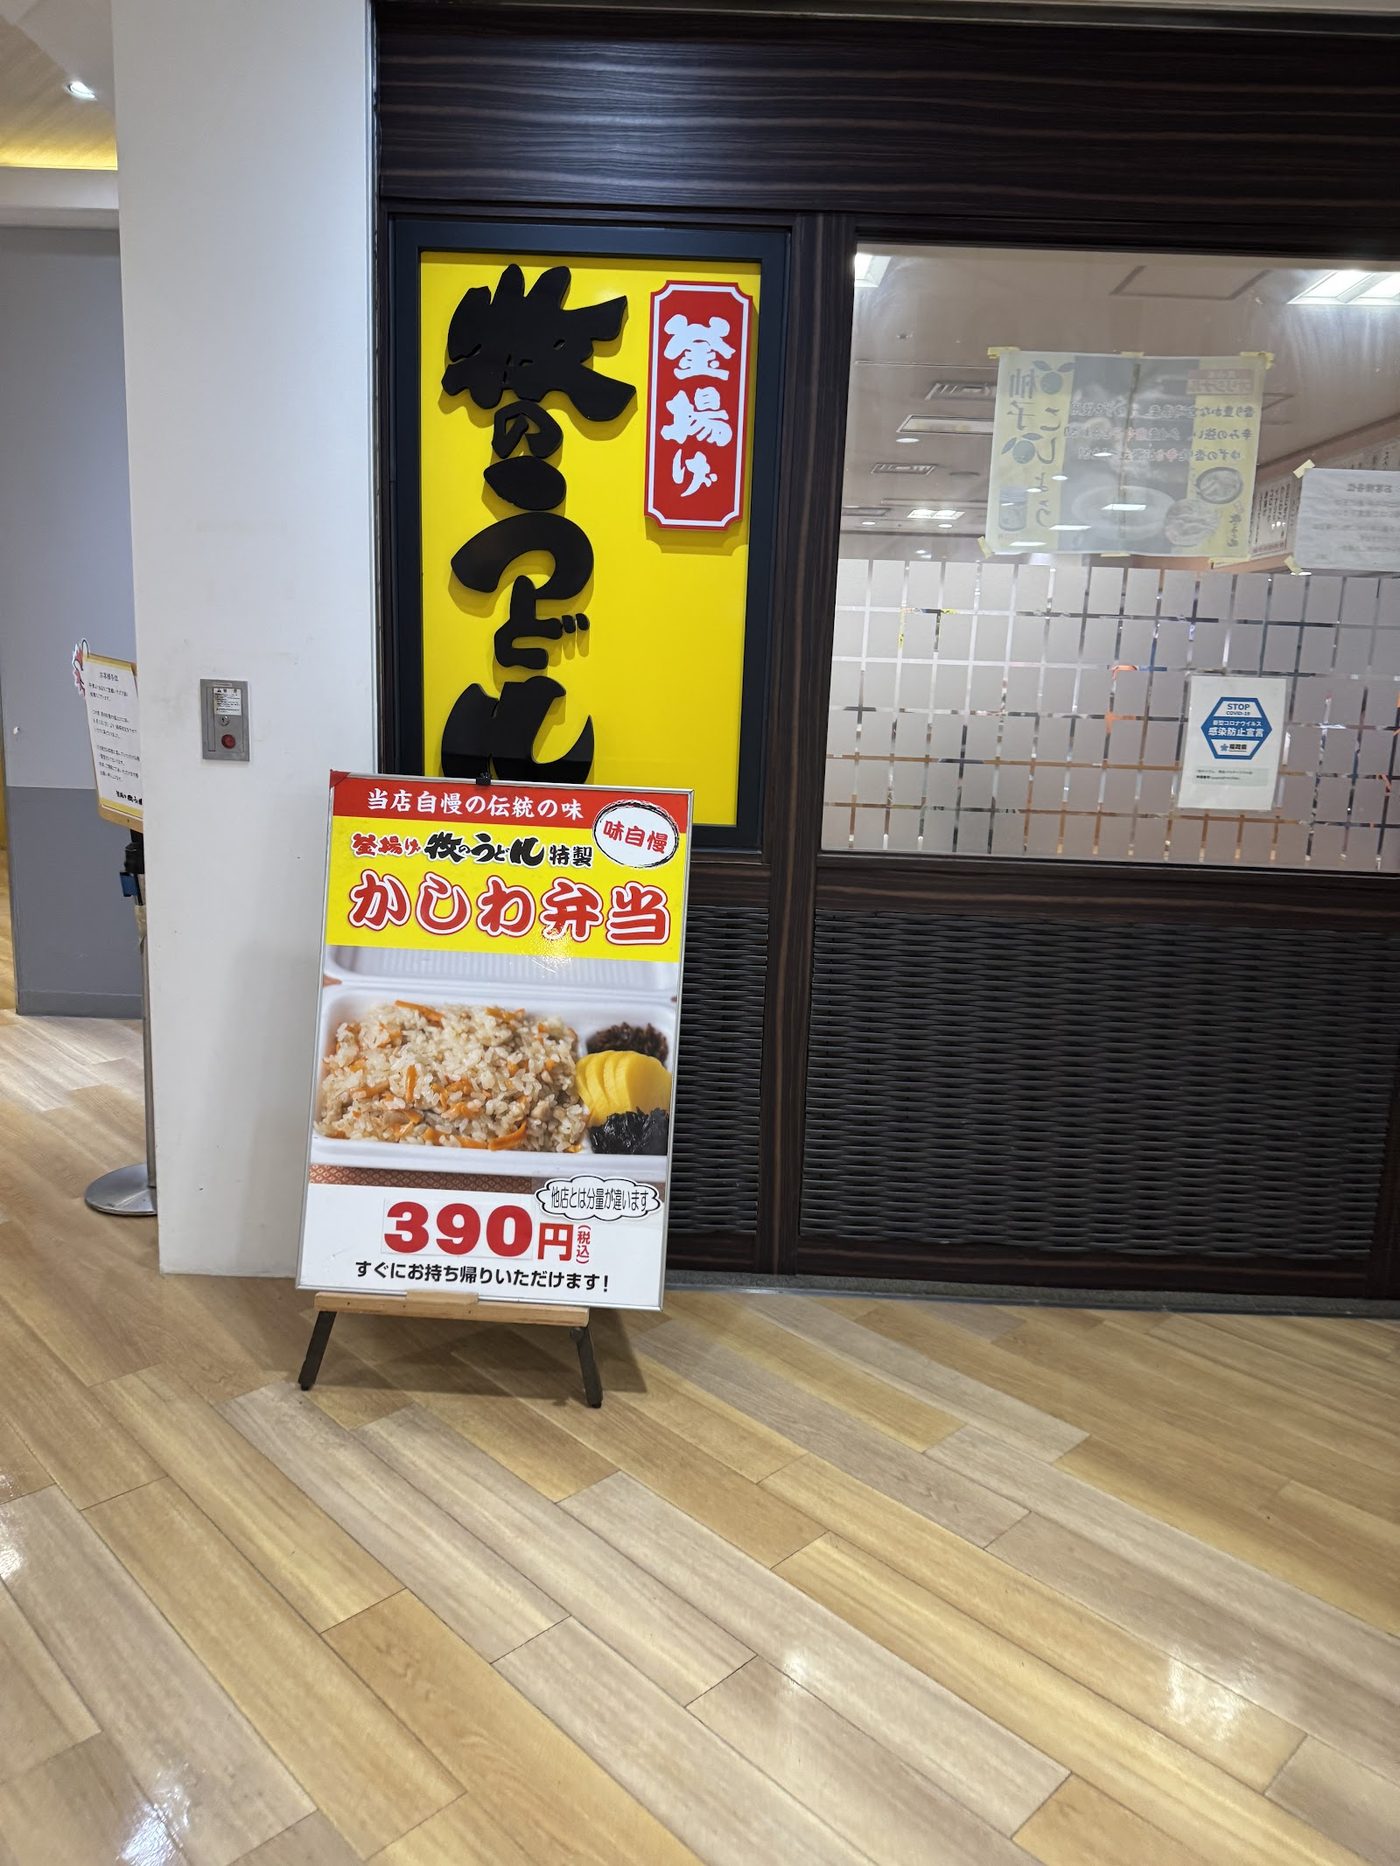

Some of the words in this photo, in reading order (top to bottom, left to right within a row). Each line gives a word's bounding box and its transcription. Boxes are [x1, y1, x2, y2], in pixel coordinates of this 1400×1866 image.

[660, 313, 737, 497] 釜揚げ
[441, 263, 637, 785] 牧のうどん
[1227, 703, 1250, 711] STOP
[1208, 727, 1264, 738] 感染防止宣言
[367, 787, 584, 821] 当店自慢の伝統の味
[602, 820, 671, 855] 味自慢
[348, 869, 671, 946] かしわ弁当
[550, 1186, 650, 1212] 他店とは分量が違います
[354, 1260, 610, 1293] すぐにお持ち帰りいただけます！
